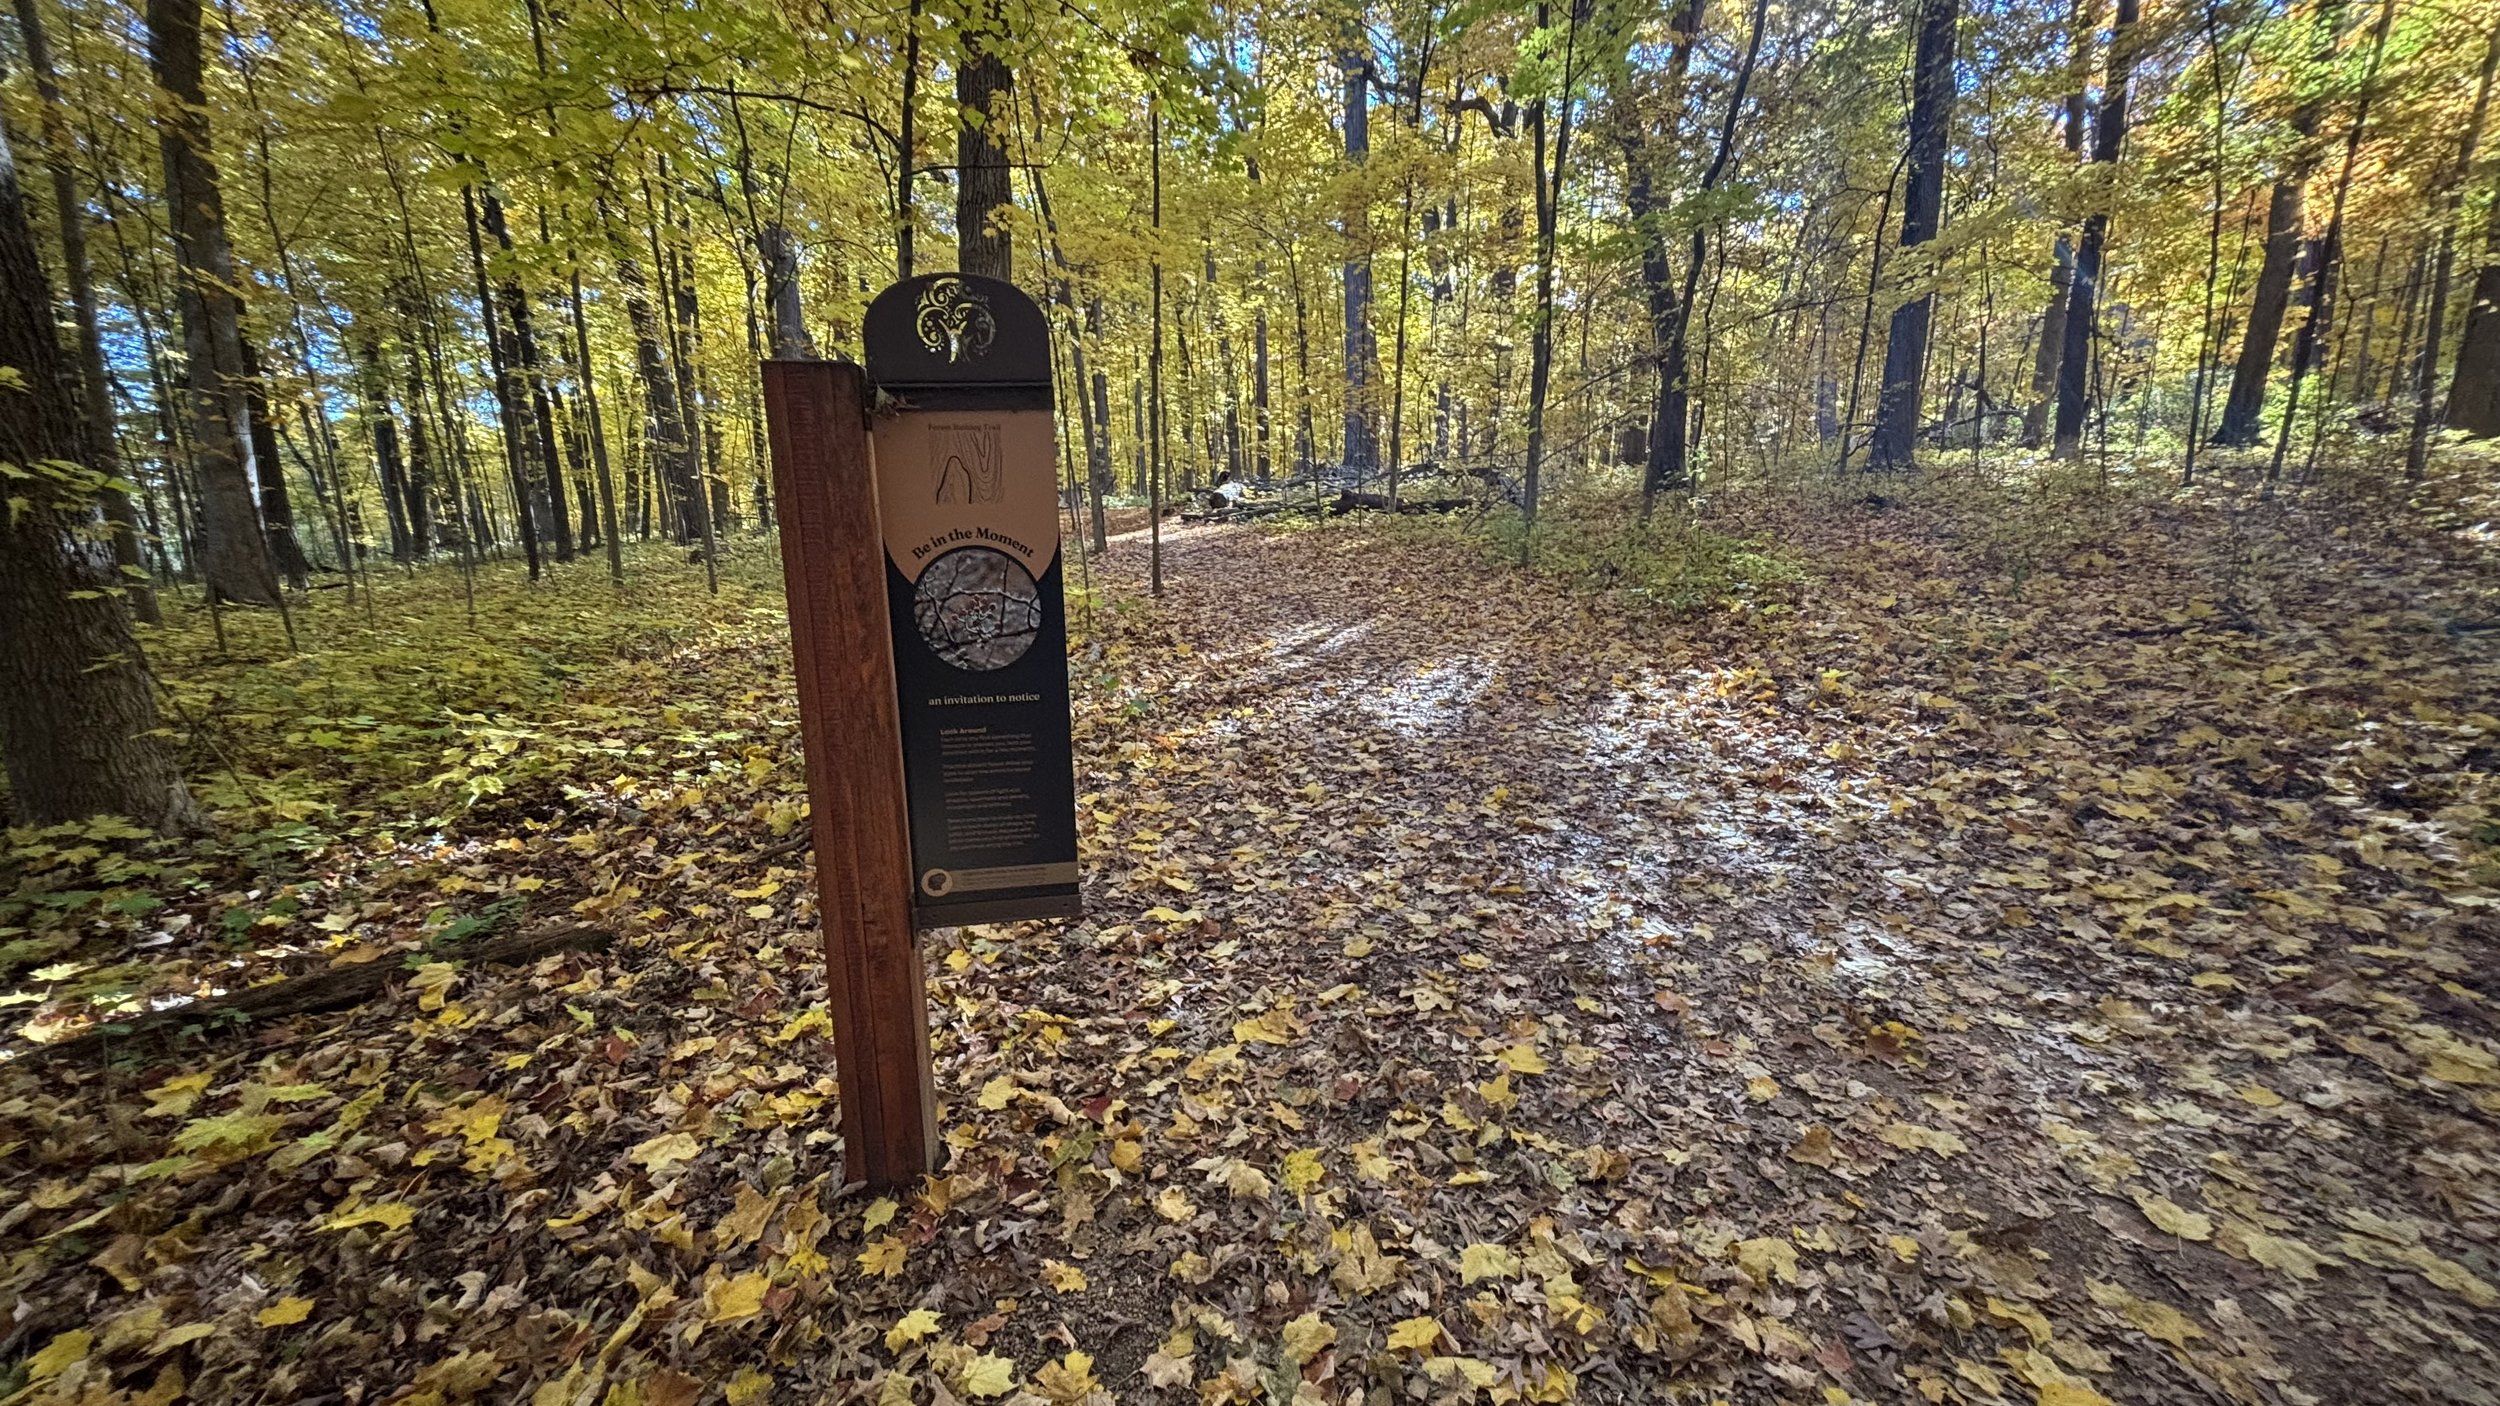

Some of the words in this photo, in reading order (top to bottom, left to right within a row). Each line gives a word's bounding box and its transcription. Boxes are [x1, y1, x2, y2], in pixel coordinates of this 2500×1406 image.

[983, 422, 1001, 431] Trail
[912, 543, 931, 560] Be
[931, 536, 947, 548] in
[948, 528, 972, 541] the
[976, 527, 1035, 558] Moment
[928, 697, 942, 706] an
[944, 694, 994, 706] invitation
[996, 694, 1007, 703] to
[1009, 692, 1040, 703] notice
[940, 727, 957, 735] Look
[960, 726, 987, 734] Around
